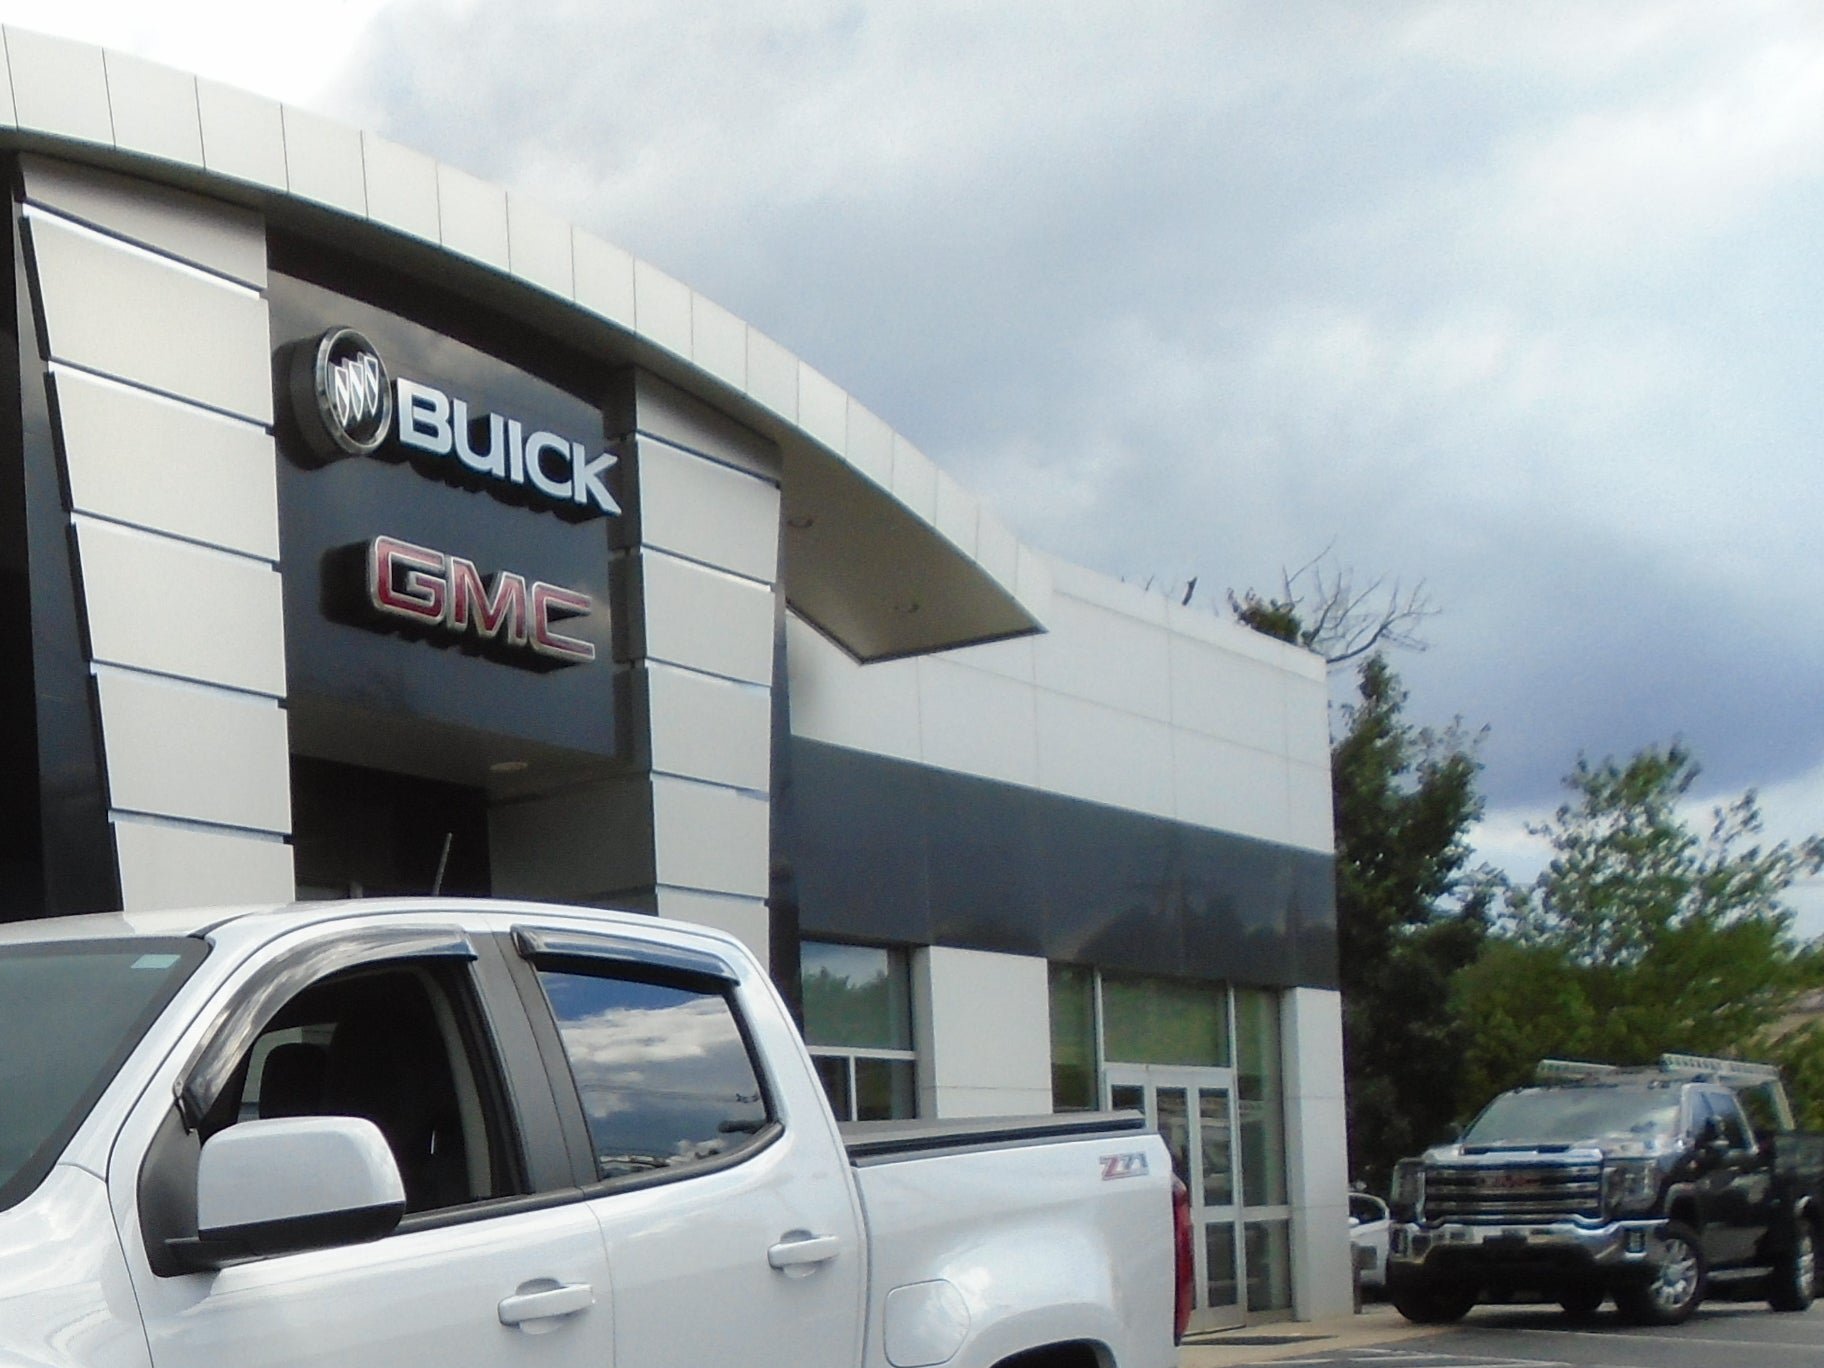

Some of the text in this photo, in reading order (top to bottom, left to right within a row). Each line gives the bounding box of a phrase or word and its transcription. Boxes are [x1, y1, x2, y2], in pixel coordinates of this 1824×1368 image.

[397, 377, 622, 516] BUICK
[370, 535, 595, 661] GMC
[1099, 1150, 1149, 1181] Z71
